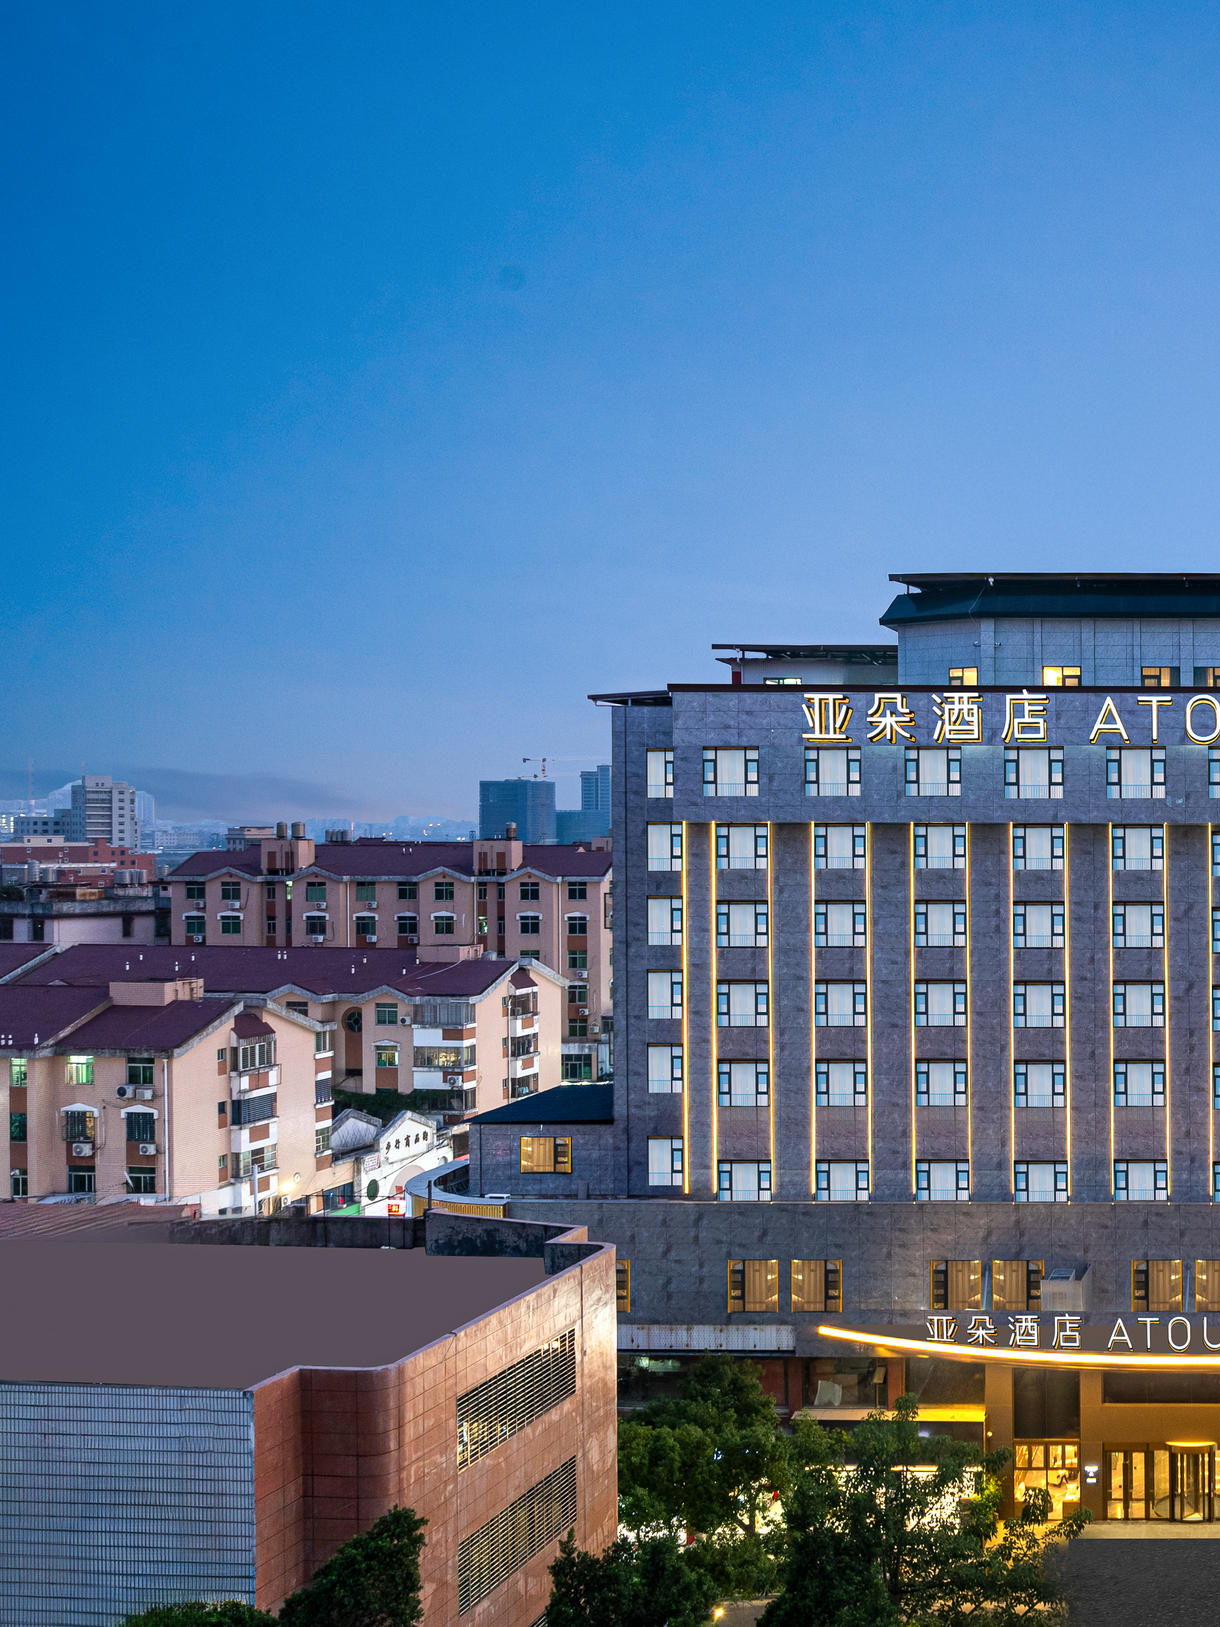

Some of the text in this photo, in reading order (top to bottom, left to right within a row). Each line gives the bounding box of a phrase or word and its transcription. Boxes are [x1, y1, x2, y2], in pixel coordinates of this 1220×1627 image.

[801, 689, 1049, 743] 亚朵酒店
[926, 1313, 1082, 1349] 亚朵酒店
